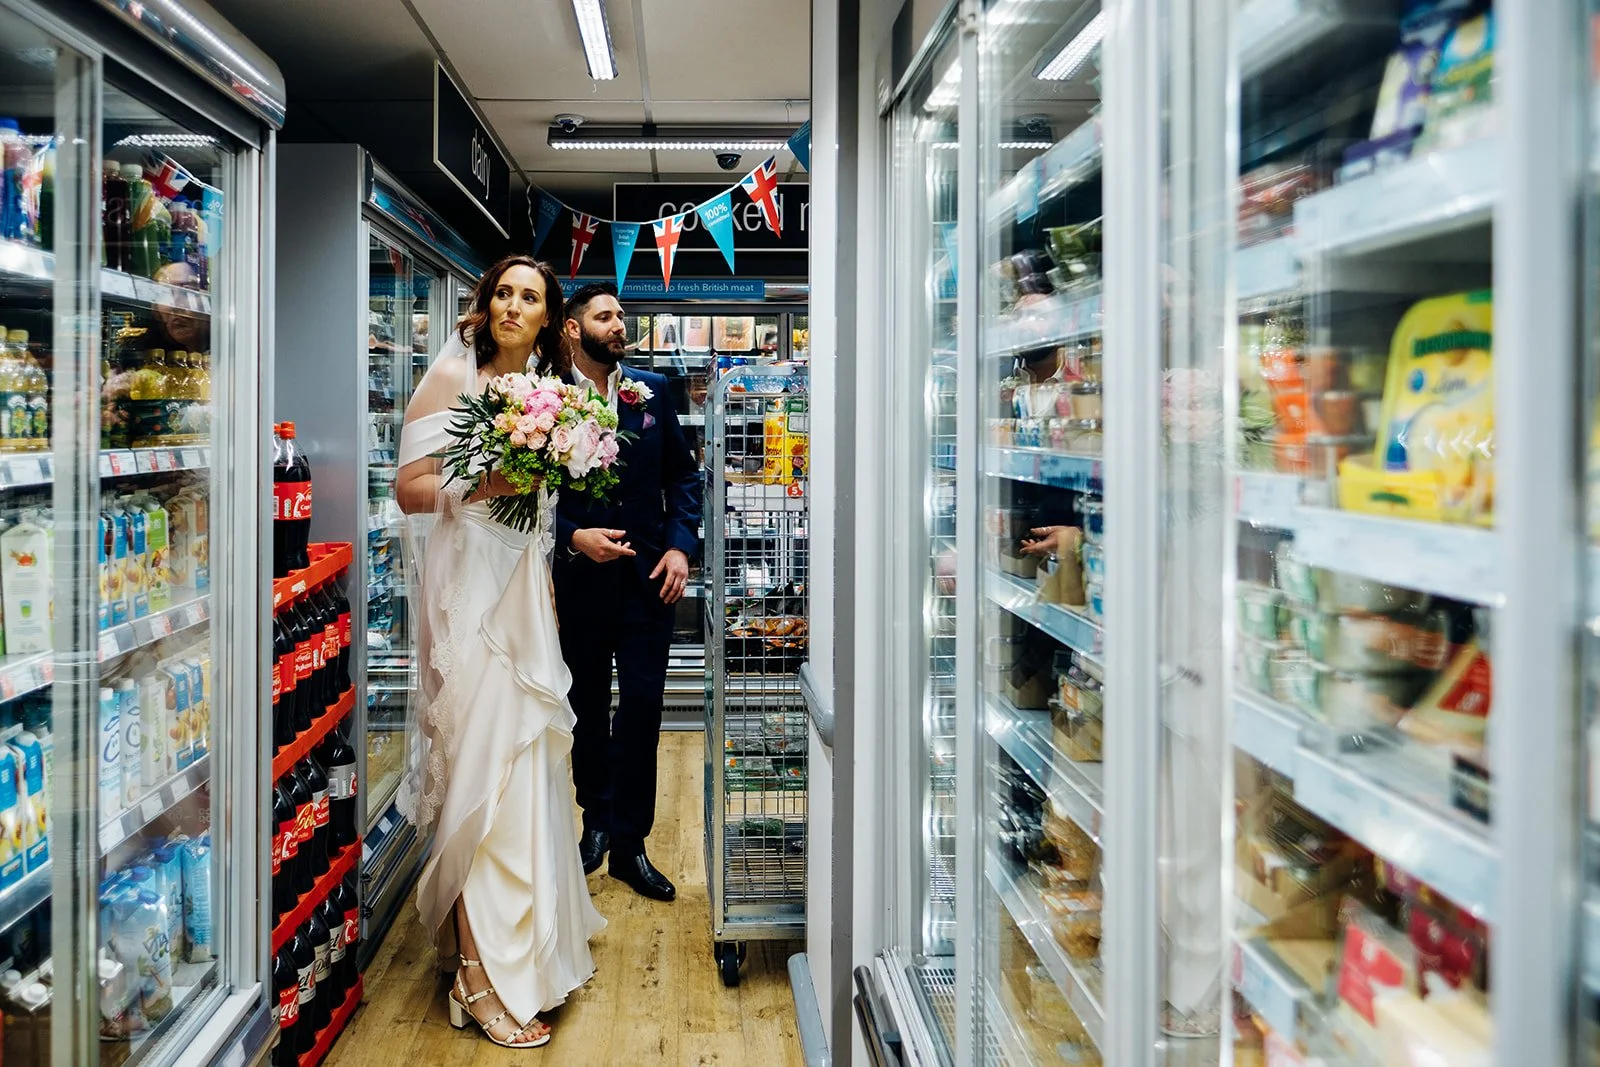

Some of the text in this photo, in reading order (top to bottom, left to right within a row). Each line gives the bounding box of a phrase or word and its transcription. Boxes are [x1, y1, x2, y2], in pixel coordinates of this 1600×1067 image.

[472, 128, 491, 200] dairy
[658, 193, 784, 231] coked
[704, 202, 728, 220] 100%
[624, 283, 663, 291] mmitted
[677, 283, 700, 291] fresh
[702, 283, 729, 291] British
